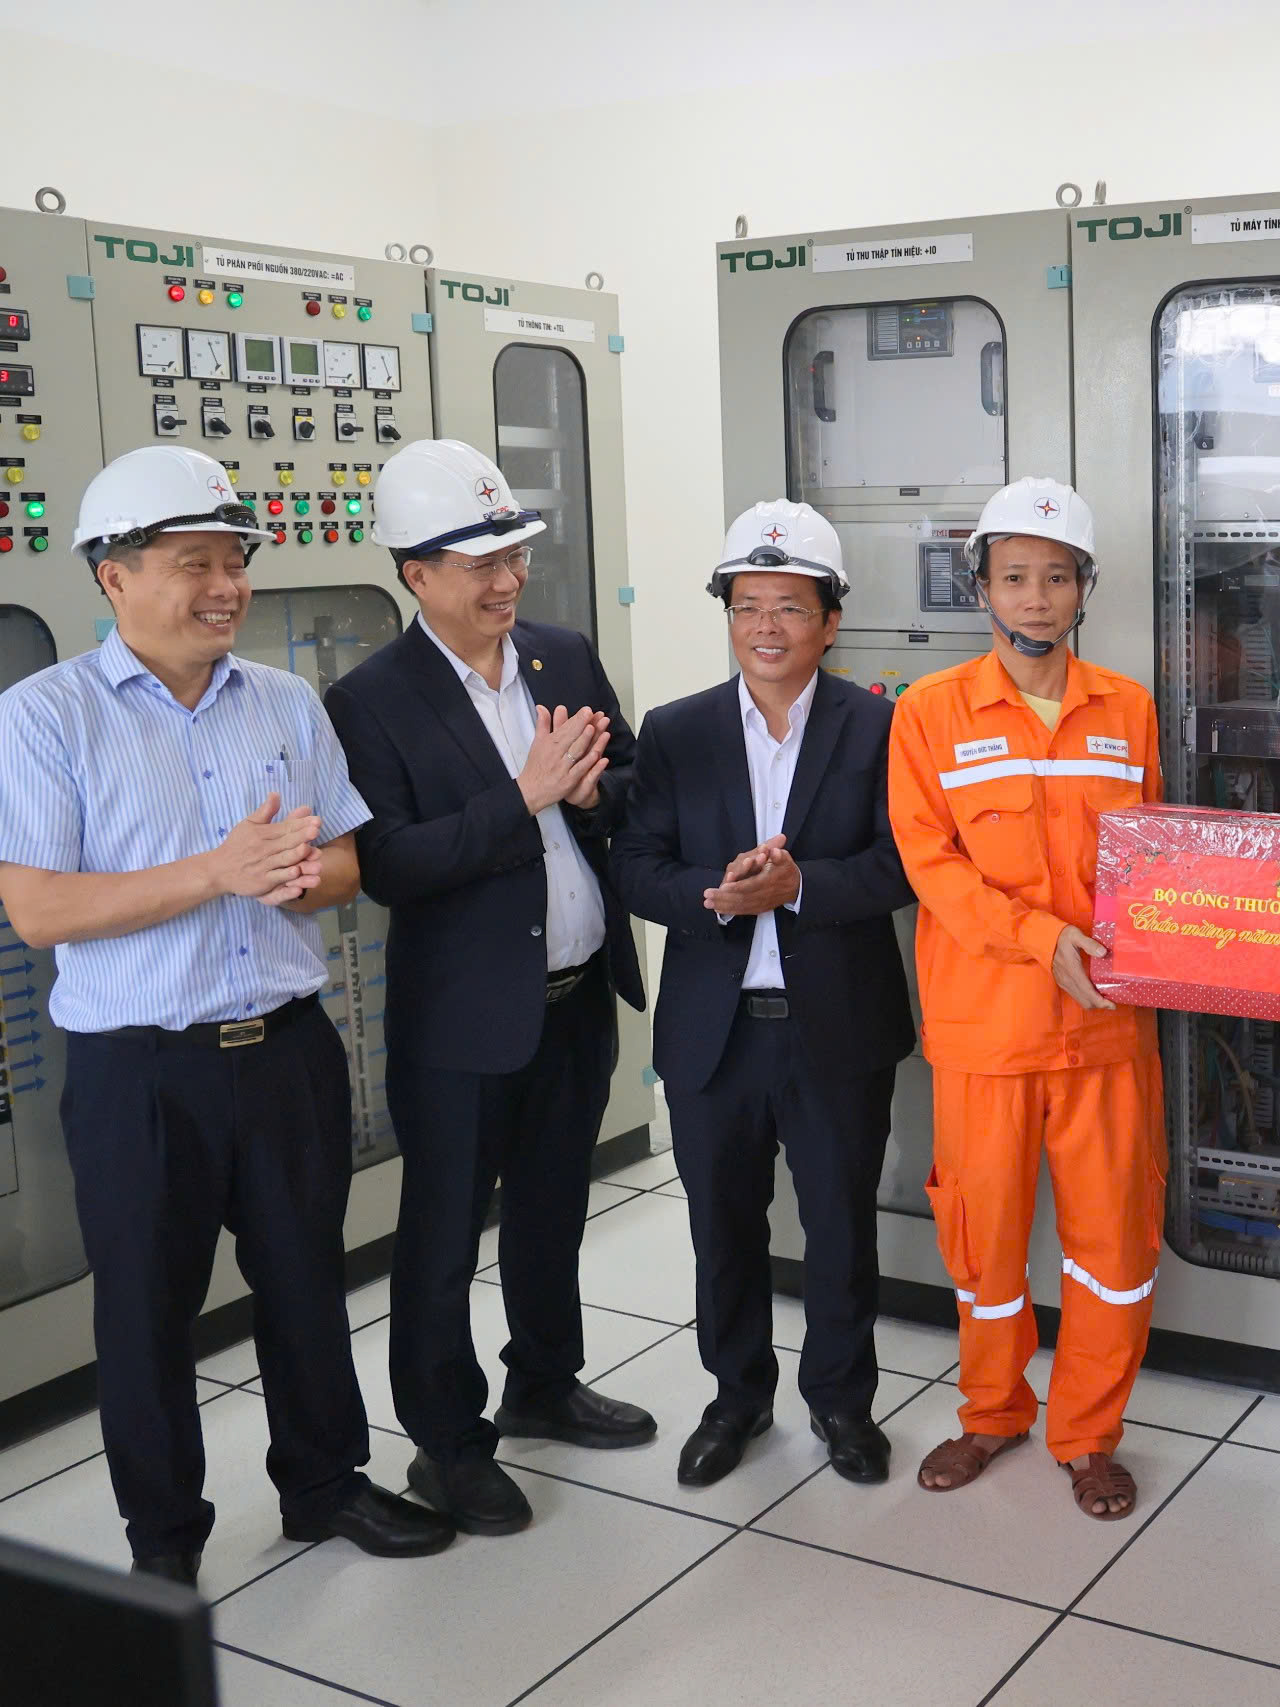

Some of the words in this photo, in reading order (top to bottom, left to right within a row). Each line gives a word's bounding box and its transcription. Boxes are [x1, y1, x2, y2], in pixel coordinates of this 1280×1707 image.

[1077, 212, 1182, 243] TOJI
[1230, 217, 1241, 232] TỦ
[1242, 218, 1262, 231] MÁY
[94, 234, 194, 268] TOJI
[720, 245, 806, 273] TOJI
[846, 248, 855, 261] TỦ
[856, 250, 870, 261] THU
[871, 248, 889, 261] THẬP
[289, 266, 330, 280] 380/220VAC:
[440, 279, 510, 307] TOJI
[1153, 887, 1178, 907] BỘ
[1180, 888, 1230, 910] CÔNG
[1181, 919, 1237, 950] mừng
